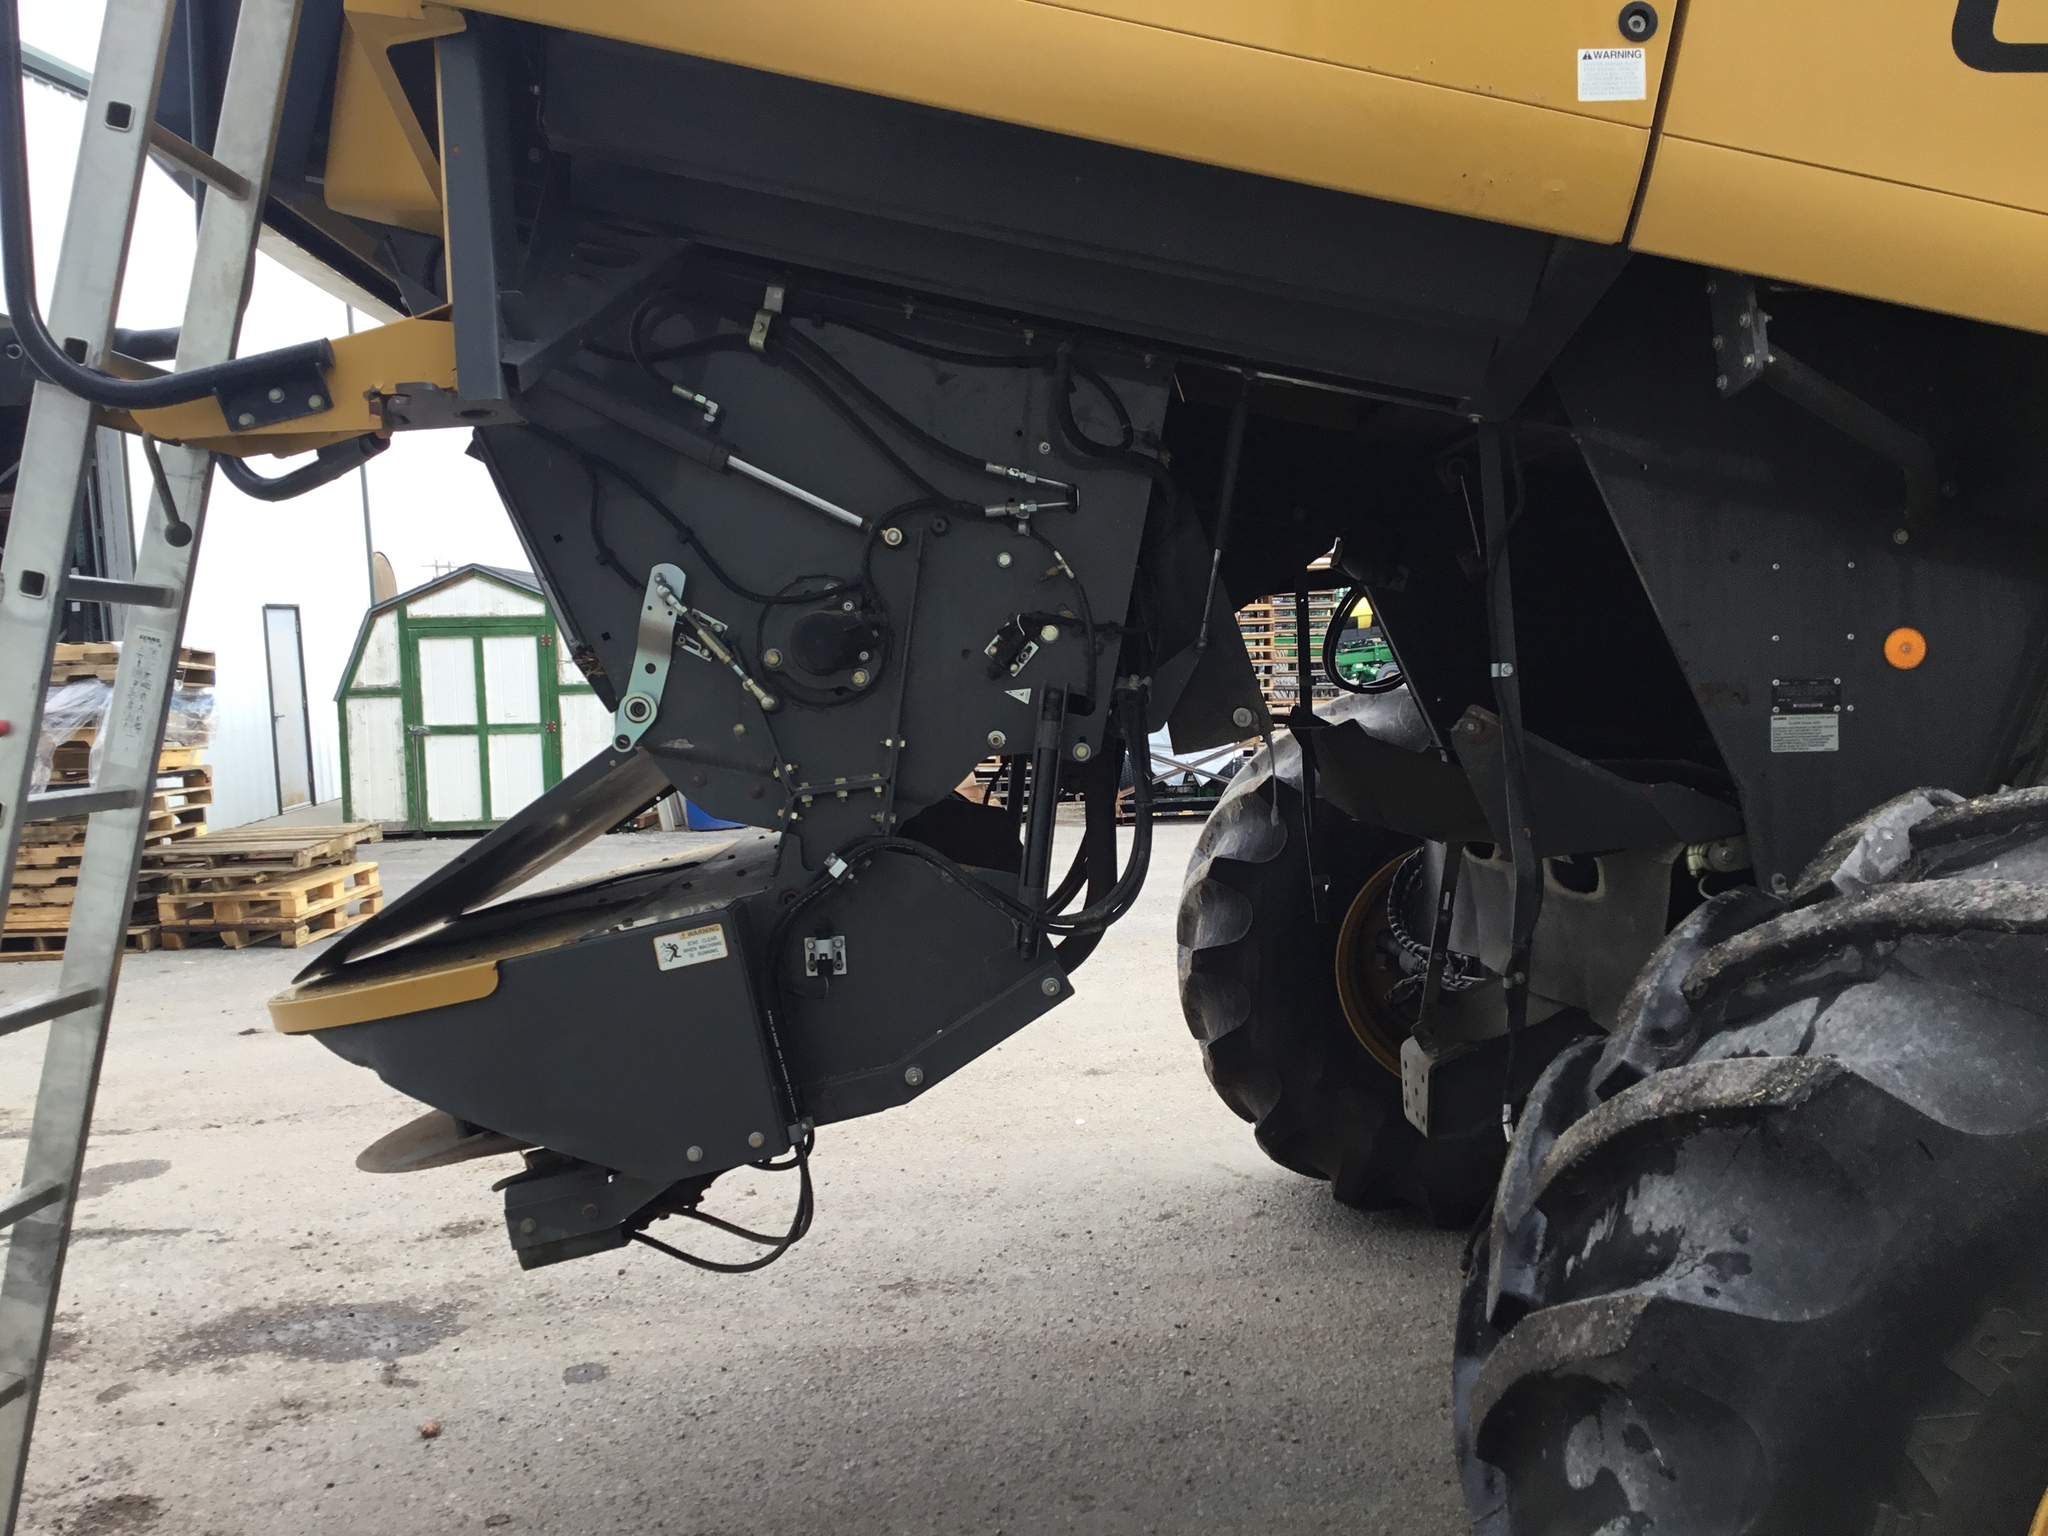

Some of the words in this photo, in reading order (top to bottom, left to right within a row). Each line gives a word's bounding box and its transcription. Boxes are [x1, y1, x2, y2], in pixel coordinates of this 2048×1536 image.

[1593, 50, 1642, 59] WARNING
[687, 925, 719, 937] WARNING
[699, 941, 722, 950] MACHINE
[698, 948, 719, 956] RUNNING
